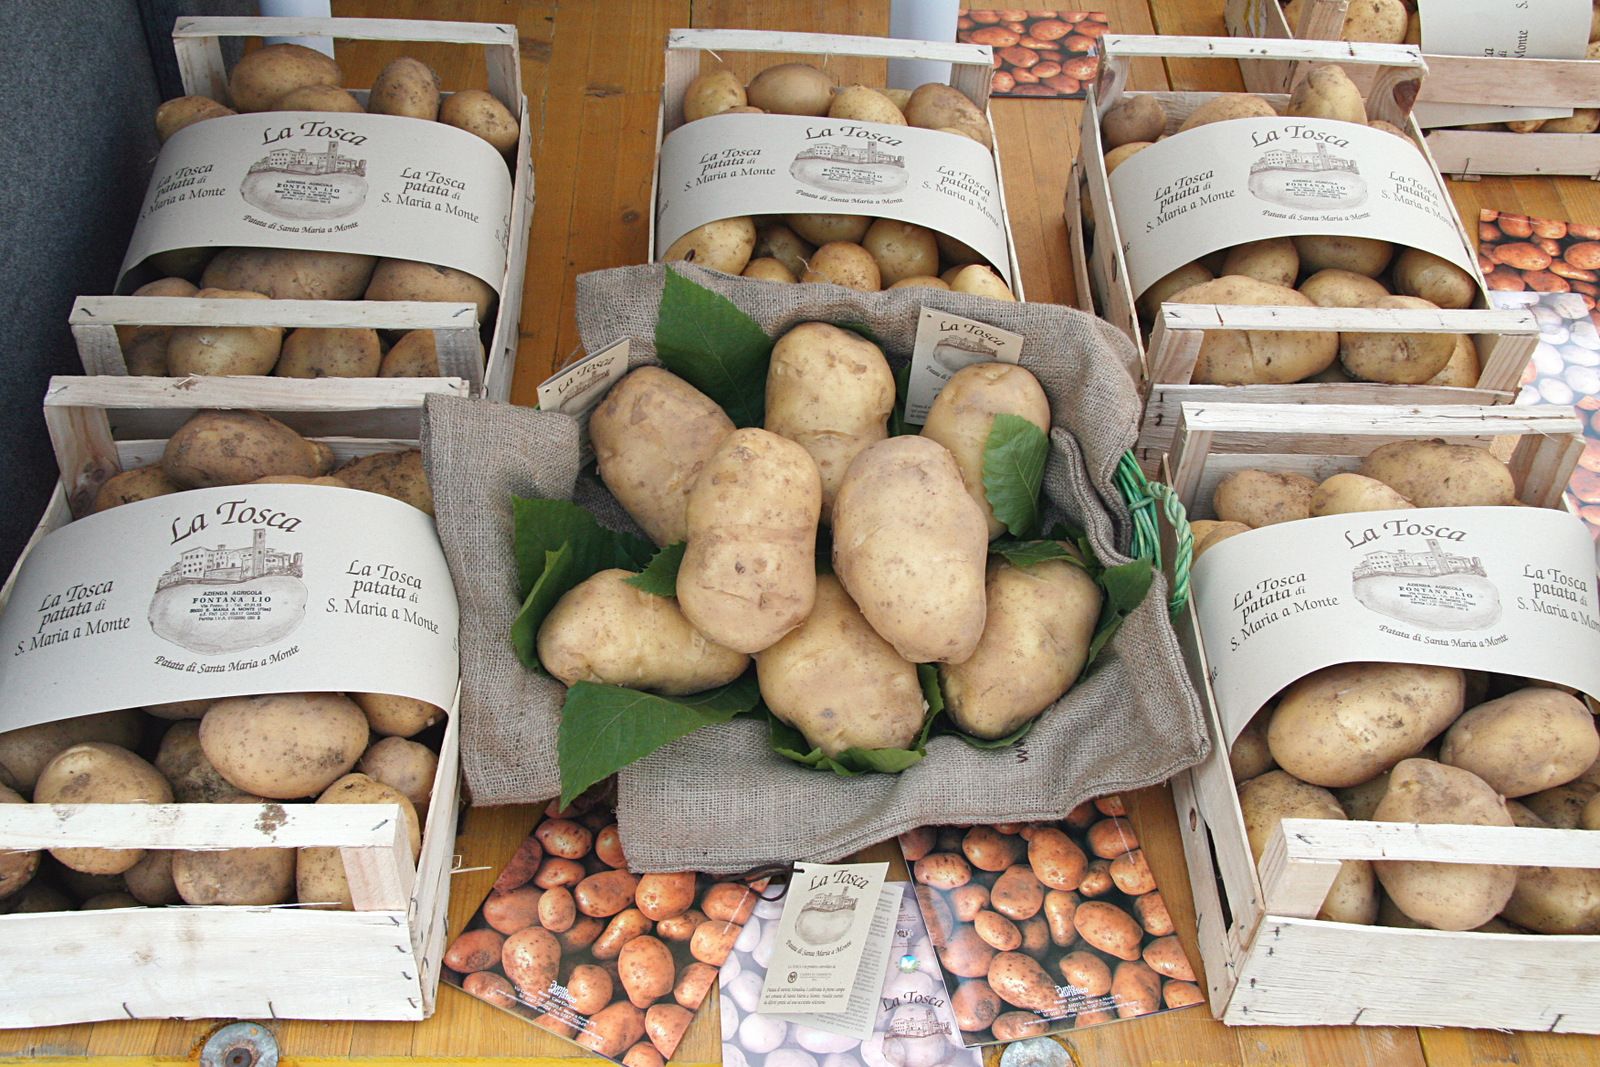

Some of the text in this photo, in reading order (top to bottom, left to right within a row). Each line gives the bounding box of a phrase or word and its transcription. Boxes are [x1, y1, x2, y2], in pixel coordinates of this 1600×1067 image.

[261, 121, 368, 146] La Tosca
[805, 125, 903, 147] La Tosca
[1251, 125, 1350, 148] La Tosca
[698, 148, 761, 165] La Tosca
[700, 158, 744, 176] patata
[175, 164, 214, 179] Tosca
[400, 167, 466, 191] La Tosca
[696, 172, 727, 186] Maria
[740, 168, 776, 176] Monte
[936, 165, 991, 197] La Tosca
[154, 176, 207, 204] patata di
[402, 181, 460, 201] patata di
[795, 189, 818, 199] Patata
[922, 180, 932, 190] S.
[935, 183, 966, 201] Maria
[940, 176, 979, 197] patata
[1153, 170, 1214, 201] La Tosca
[1159, 182, 1211, 214] patata di
[1388, 171, 1439, 201] La Tosca
[1395, 183, 1431, 202] patata
[148, 196, 176, 215] Maria
[189, 187, 226, 200] Monte
[381, 192, 480, 224] S. Maria a Monte
[1145, 189, 1235, 234] S. Maria a Monte
[1381, 189, 1431, 214] S. Maria a
[243, 215, 267, 228] Patata
[267, 222, 277, 230] di
[277, 223, 300, 233] Santa
[334, 221, 359, 233] Monte
[1262, 209, 1287, 220] Patata
[939, 320, 1006, 347] La Tosca
[169, 499, 302, 546] La Tosca
[1344, 518, 1468, 550] La Tosca
[345, 559, 422, 590] La Tosca
[1522, 564, 1588, 593] La Tosca
[37, 580, 114, 612] La Tosca
[350, 579, 418, 604] patata di
[1232, 573, 1307, 612] La Tosca
[1398, 586, 1448, 595] FONTANA
[1533, 582, 1588, 606] patata di
[37, 599, 107, 634] patata di
[325, 597, 440, 635] S. Maria a Monte
[1241, 585, 1306, 626] patata di
[1516, 596, 1578, 622] S. Maria a
[14, 617, 131, 656] S. Maria a Monte
[1230, 596, 1341, 652] S. Maria a Monte
[1378, 624, 1410, 639] Patata
[1412, 633, 1422, 642] di
[1424, 636, 1450, 646] Santa
[1450, 638, 1478, 648] Maria
[1485, 634, 1509, 648] Monte
[154, 644, 300, 674] Patata di Santa Maria a Monte
[808, 869, 870, 892] La Tosca
[881, 990, 945, 1012] La Tosca
